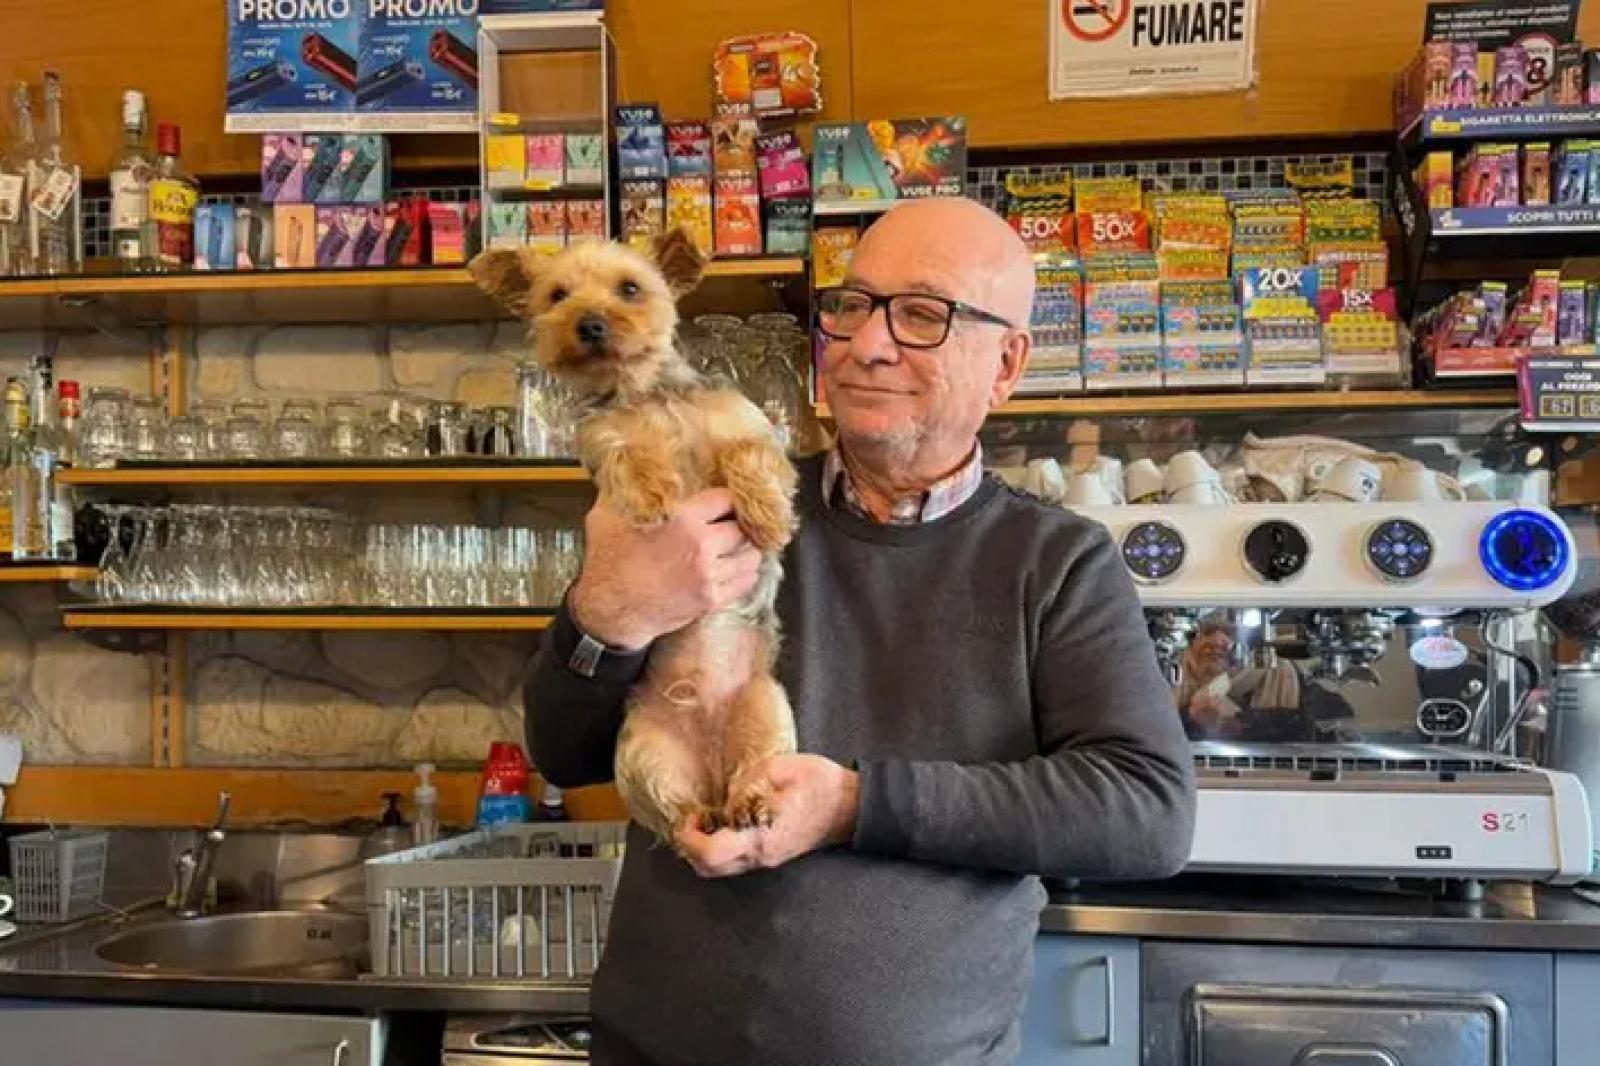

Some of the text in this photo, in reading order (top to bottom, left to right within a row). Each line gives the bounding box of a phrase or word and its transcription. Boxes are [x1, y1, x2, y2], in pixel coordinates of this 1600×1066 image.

[239, 0, 350, 21] PROMO
[370, 0, 478, 19] PROMO
[1132, 2, 1245, 48] FUMARE
[619, 107, 653, 119] VUSE
[1460, 114, 1521, 125] SIGARETTA
[1507, 211, 1554, 223] SCOPRI
